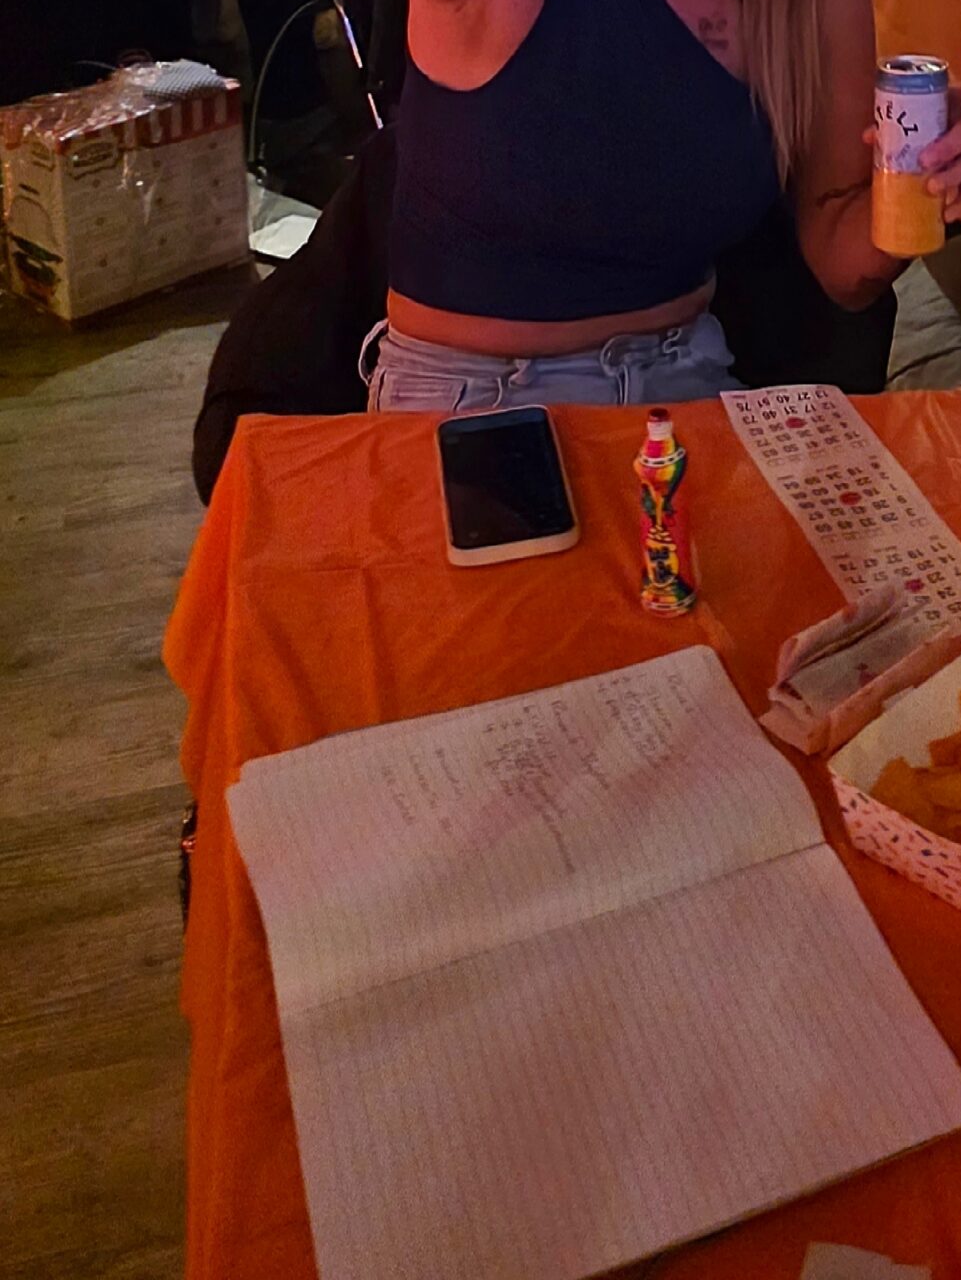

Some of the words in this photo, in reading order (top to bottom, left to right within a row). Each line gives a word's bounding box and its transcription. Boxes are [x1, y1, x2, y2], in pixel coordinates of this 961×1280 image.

[798, 392, 810, 401] 27
[815, 390, 828, 399] 13
[736, 402, 751, 412] 75
[758, 398, 770, 407] 51
[784, 406, 797, 415] 31
[805, 404, 816, 413] 17
[743, 415, 757, 424] 73
[763, 411, 776, 420] 46
[783, 444, 798, 452] 50
[856, 477, 871, 485] 22
[905, 508, 915, 516] 3
[881, 513, 898, 522] 29
[931, 543, 946, 552] 11
[938, 554, 955, 563] 14
[917, 560, 934, 570] 20
[927, 572, 945, 583] 23
[937, 587, 956, 599] 24
[925, 610, 940, 620] 42
